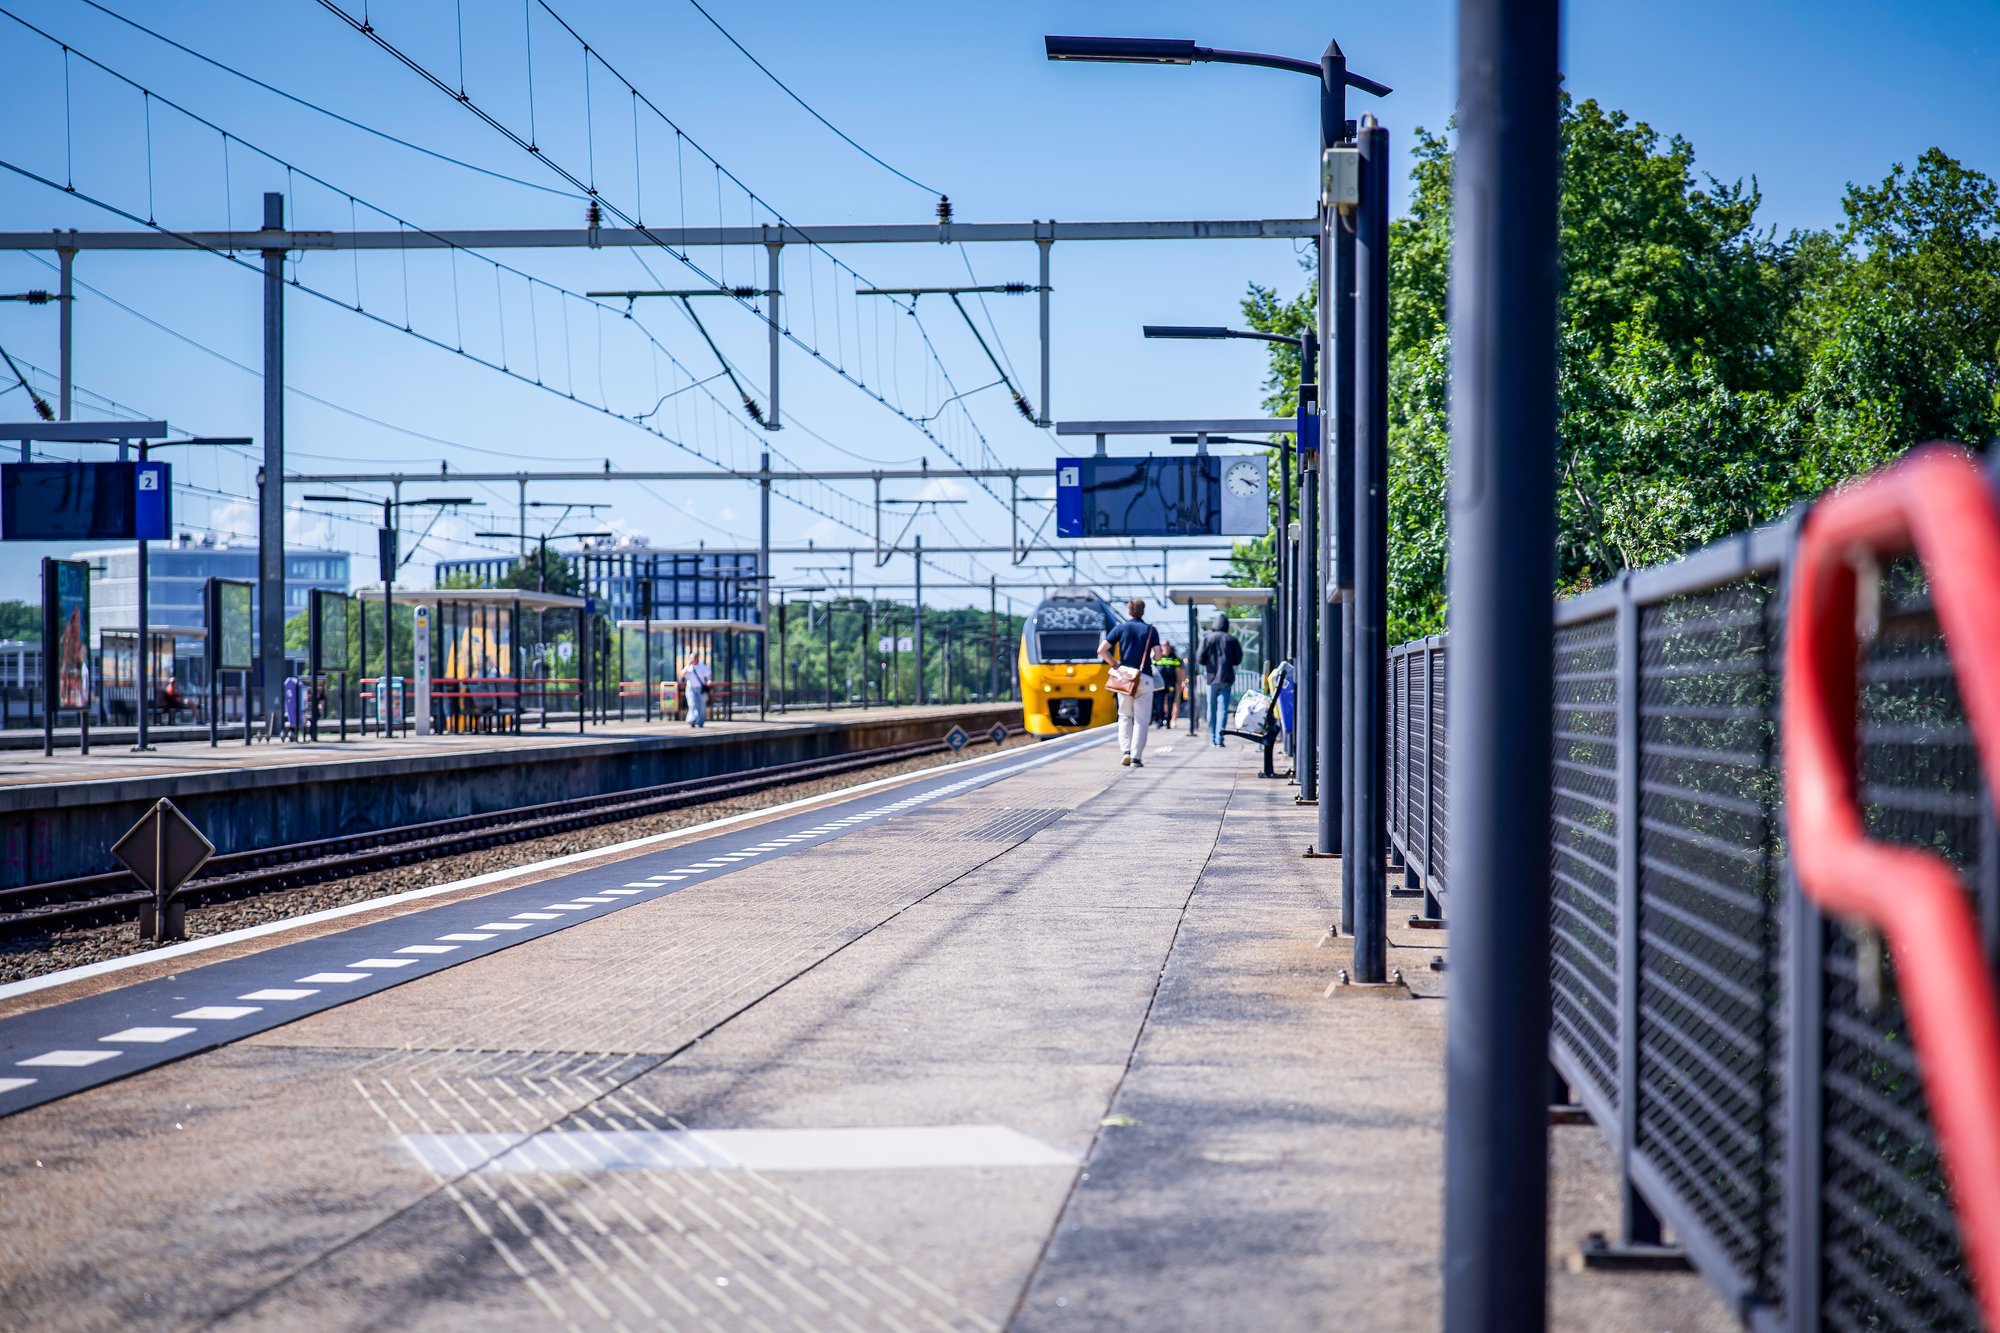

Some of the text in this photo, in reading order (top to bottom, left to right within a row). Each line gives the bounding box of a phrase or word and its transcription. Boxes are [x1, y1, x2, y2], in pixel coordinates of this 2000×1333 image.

[145, 477, 152, 488] 2
[1065, 473, 1072, 485] 1
[952, 733, 962, 746] 2
